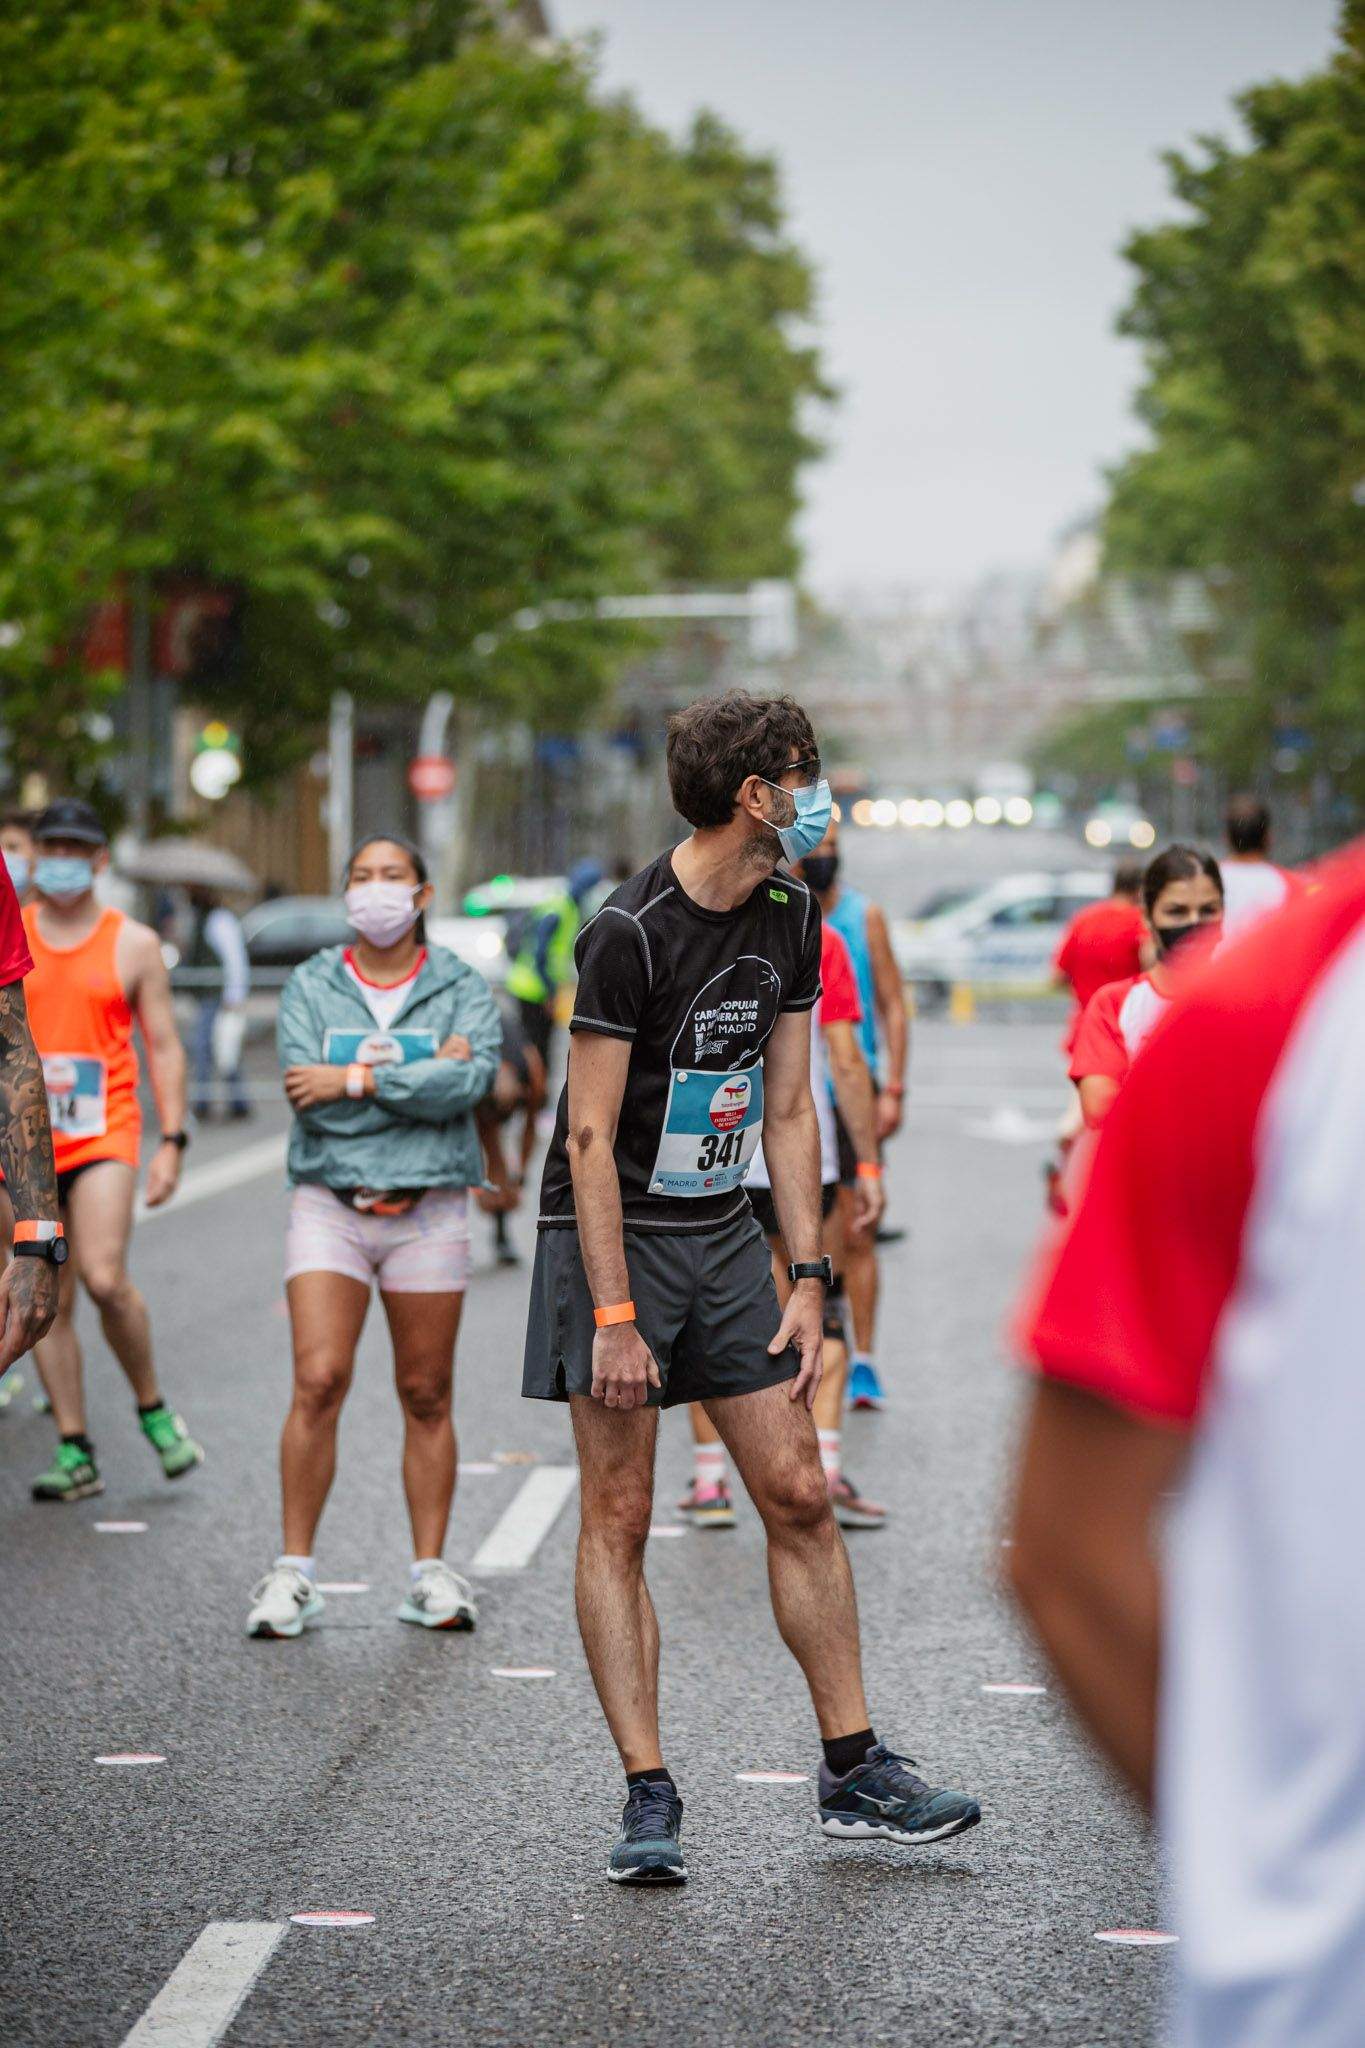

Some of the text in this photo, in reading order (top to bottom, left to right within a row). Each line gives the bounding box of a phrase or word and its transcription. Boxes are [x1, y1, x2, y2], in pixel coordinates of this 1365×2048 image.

[694, 1022, 706, 1033] LA
[718, 1023, 757, 1034] MADID
[697, 1129, 746, 1171] 341
